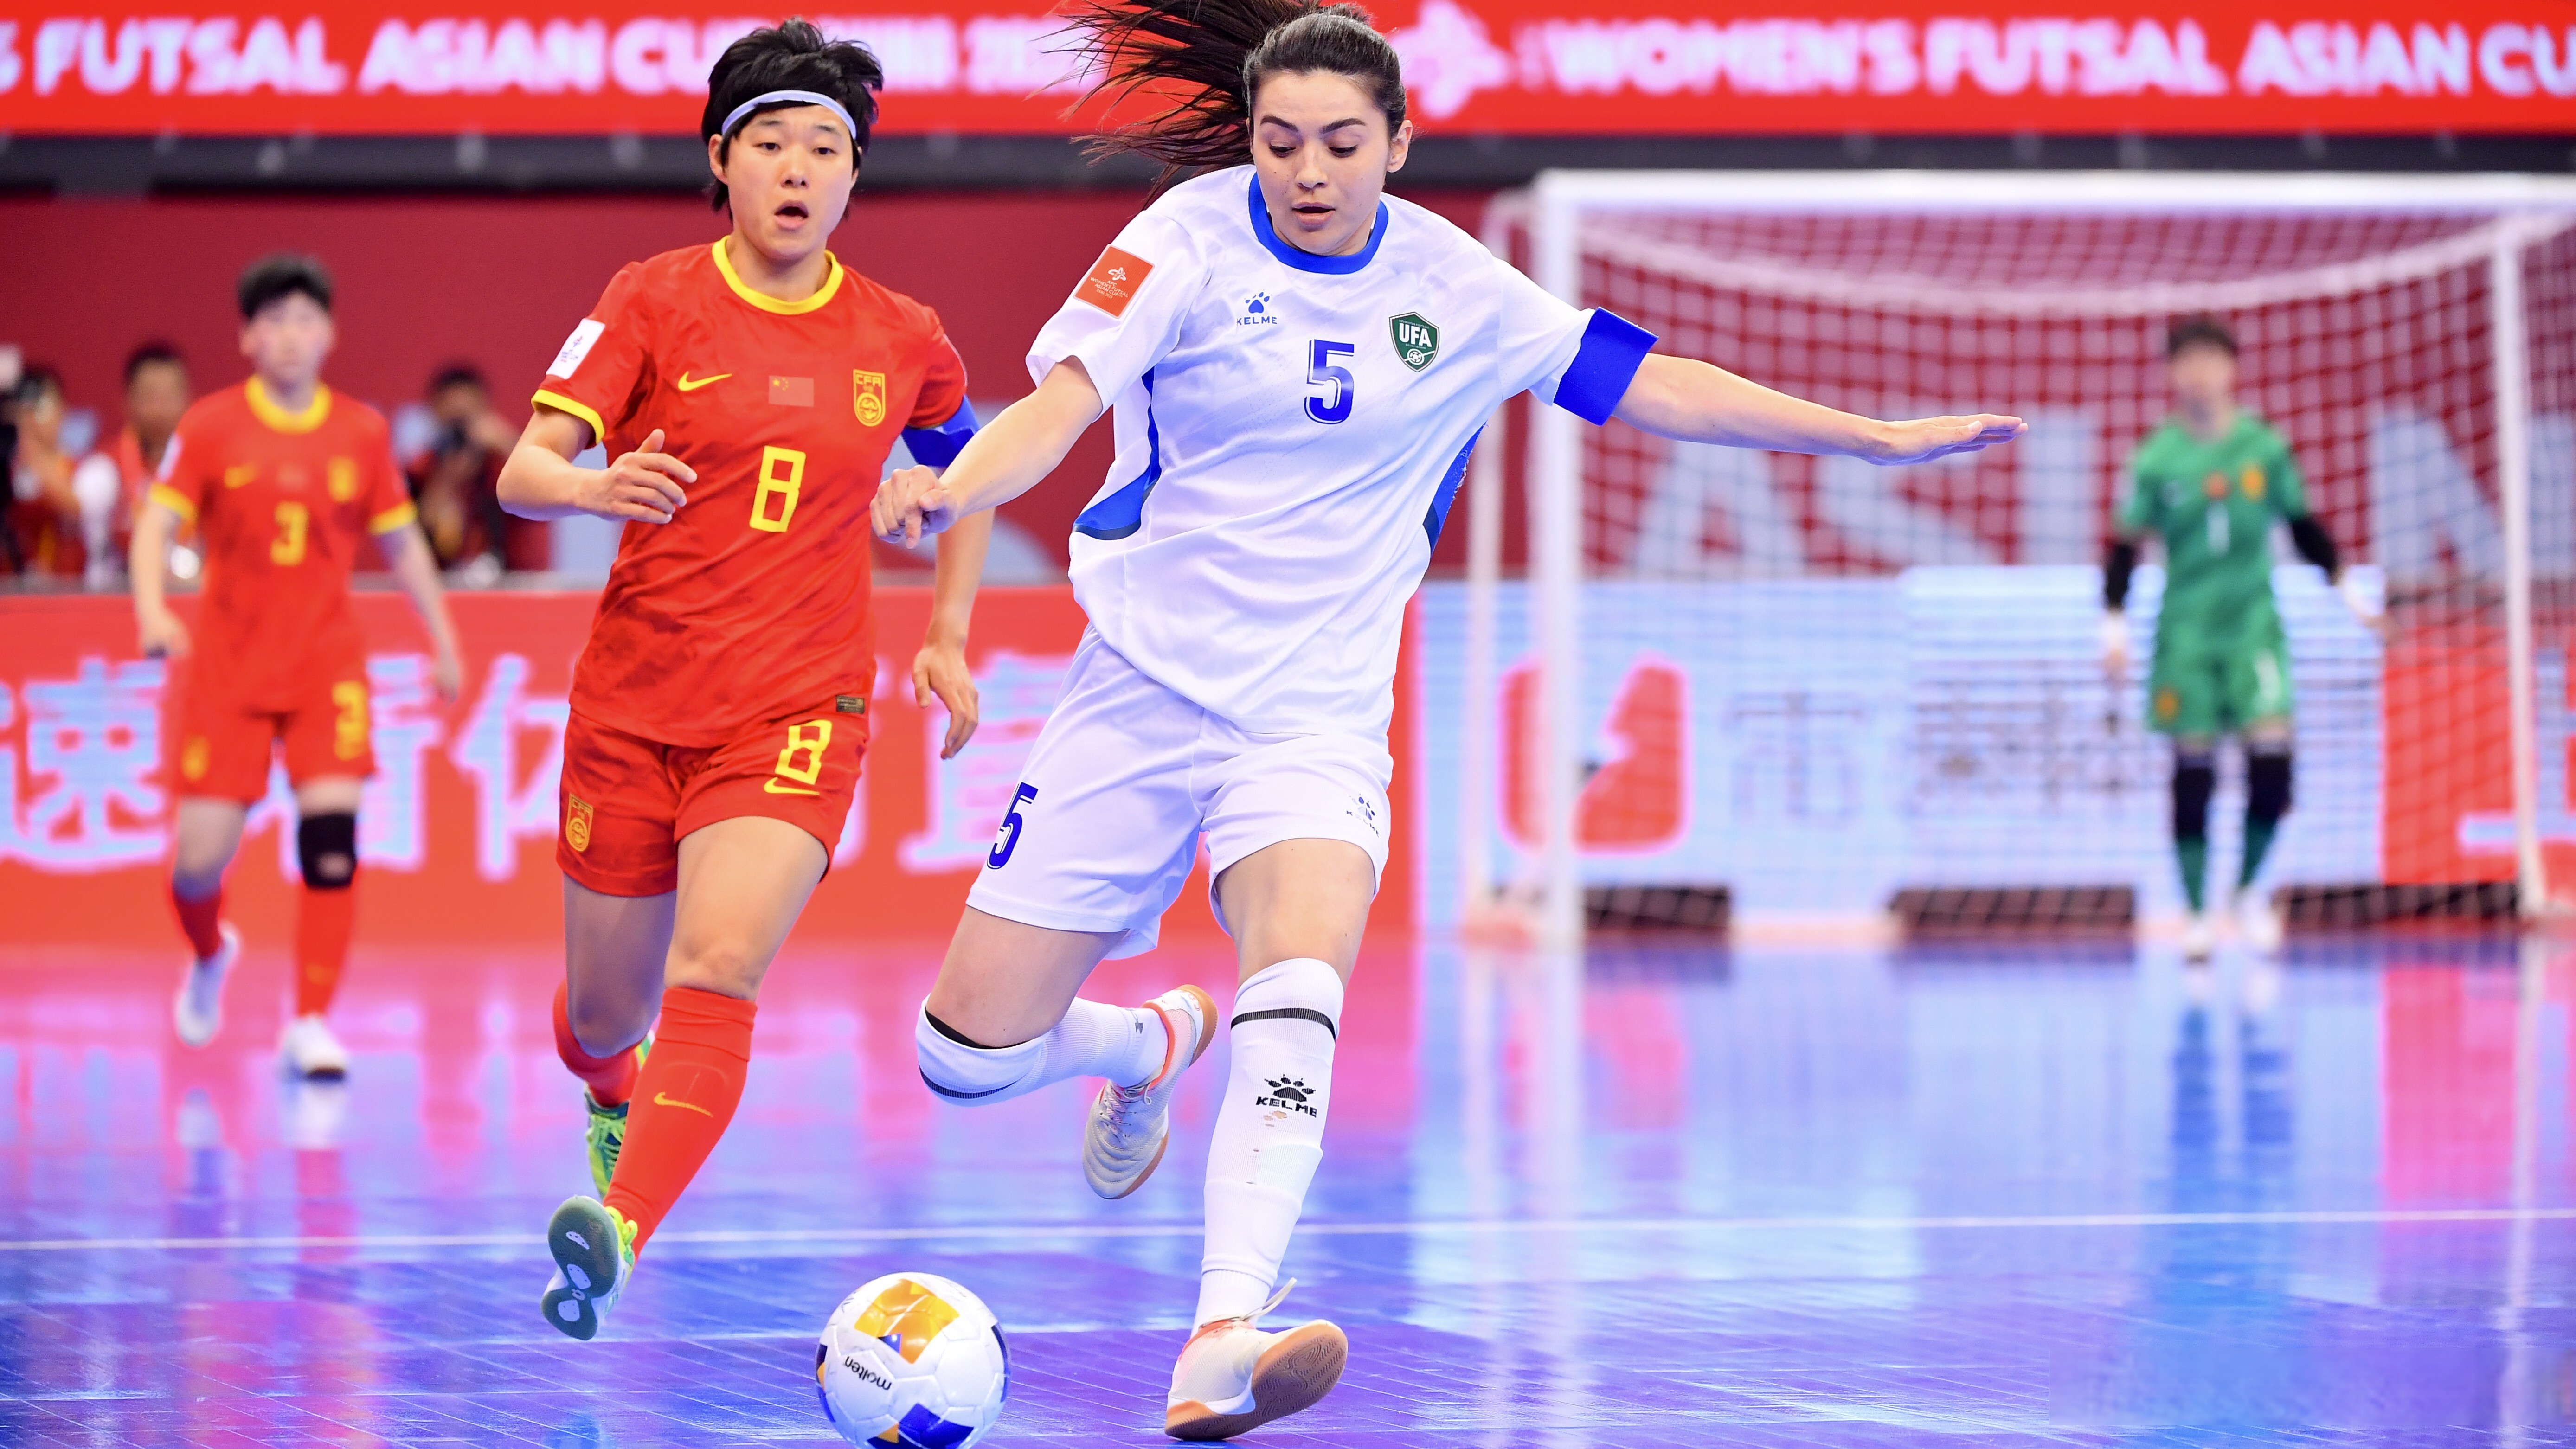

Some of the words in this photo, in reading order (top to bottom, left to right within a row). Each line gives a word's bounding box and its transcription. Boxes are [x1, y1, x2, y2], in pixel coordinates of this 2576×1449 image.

[33, 18, 347, 94] FUTSAL
[357, 18, 606, 94] ASIAN
[1924, 17, 2227, 95] FUTSAL
[2235, 19, 2469, 96] ASIAN
[1237, 316, 1277, 325] KELME
[1399, 322, 1433, 348] UFA
[855, 373, 882, 388] CFA
[1304, 339, 1355, 424] 5
[749, 446, 806, 532] 8
[270, 501, 309, 566] 3
[331, 679, 369, 762] 3
[774, 719, 832, 786] 8
[986, 782, 1039, 870] 5
[1255, 1096, 1317, 1118] KELME
[844, 1356, 892, 1391] molten
